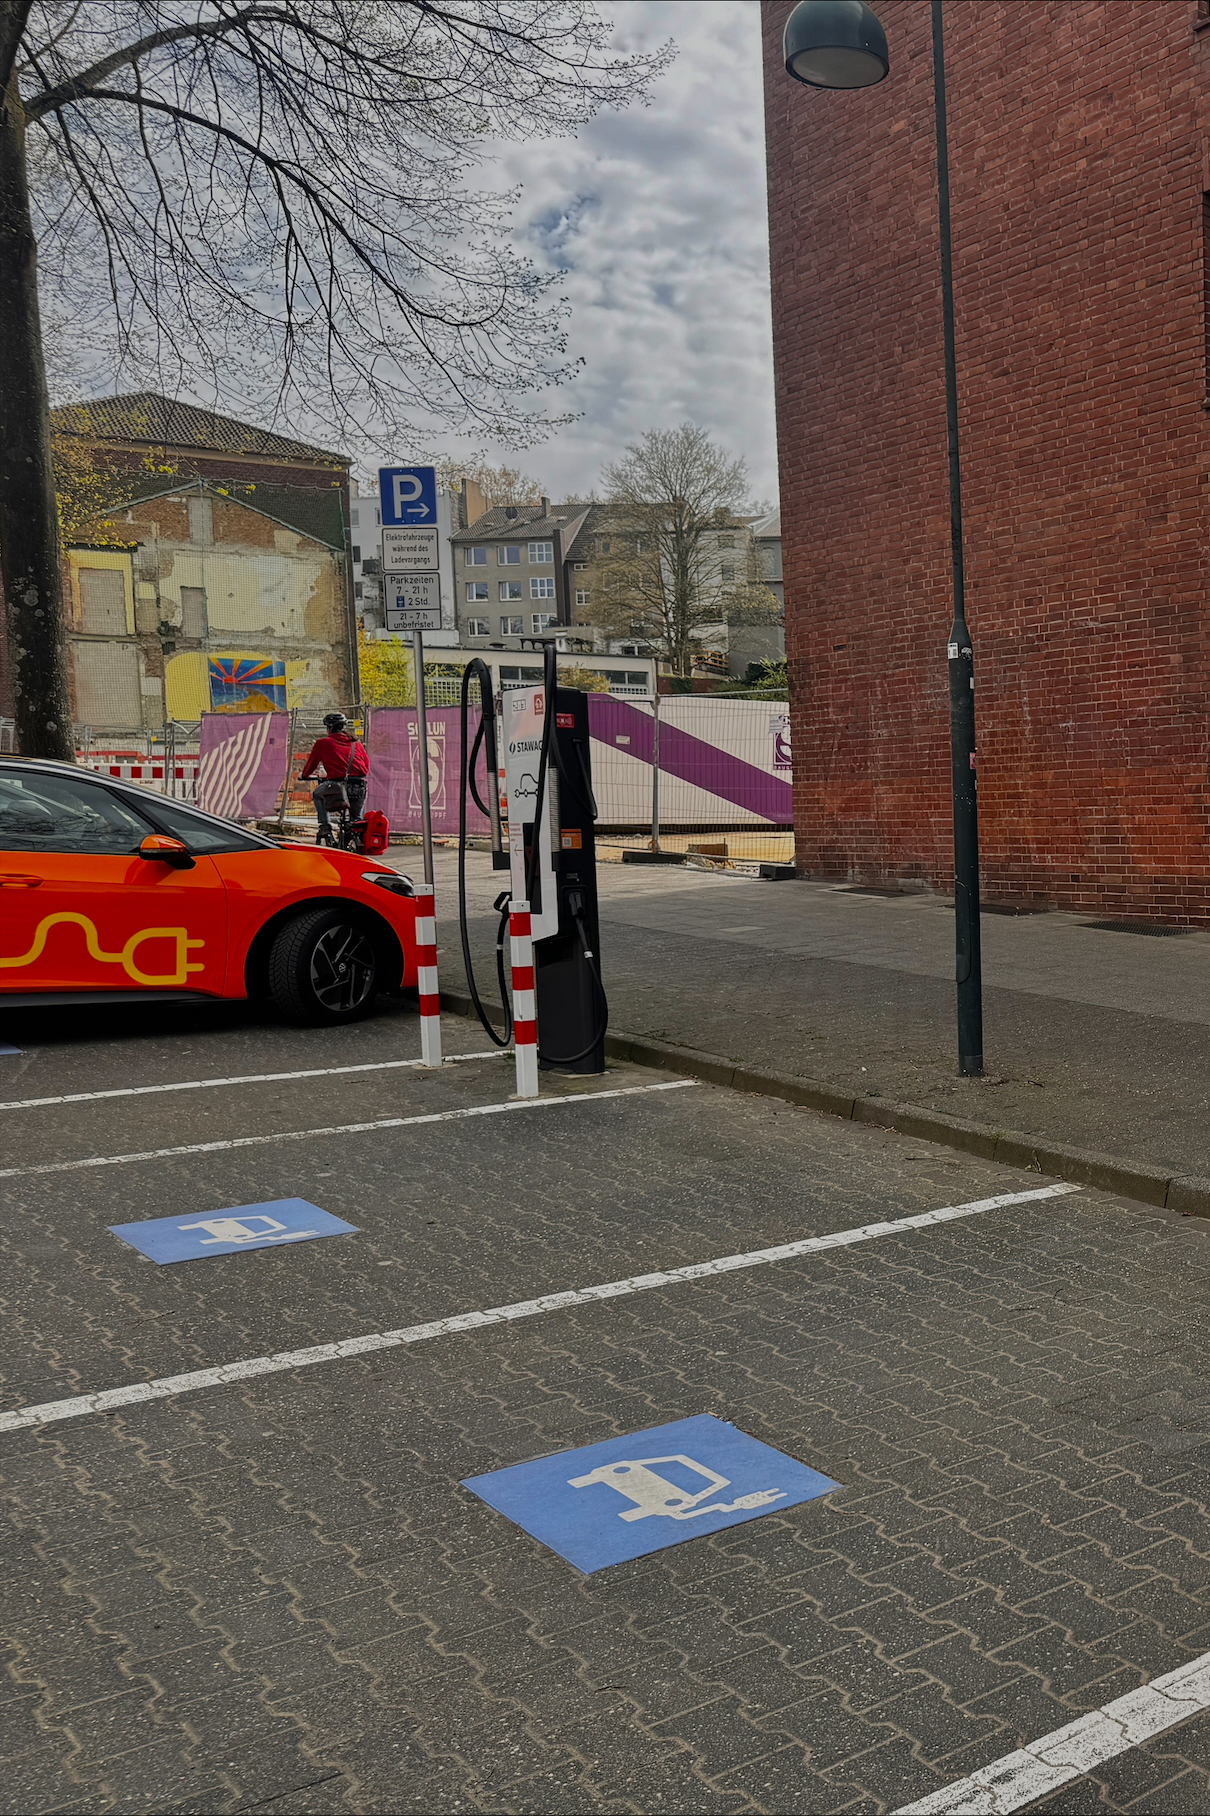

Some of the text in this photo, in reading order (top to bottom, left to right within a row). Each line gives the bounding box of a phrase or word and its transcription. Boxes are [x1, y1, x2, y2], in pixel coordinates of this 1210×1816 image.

[392, 474, 423, 519] P
[385, 533, 435, 542] Elektrofahrzeuge
[392, 544, 429, 552] während des
[390, 556, 431, 565] Ladevorgangs
[390, 576, 434, 584] Parkzeiten
[397, 586, 402, 594] 7
[412, 586, 420, 594] 21
[423, 586, 428, 594] h
[408, 597, 430, 606] 2 Std.
[416, 612, 421, 620] 7
[393, 621, 434, 629] unbefristet
